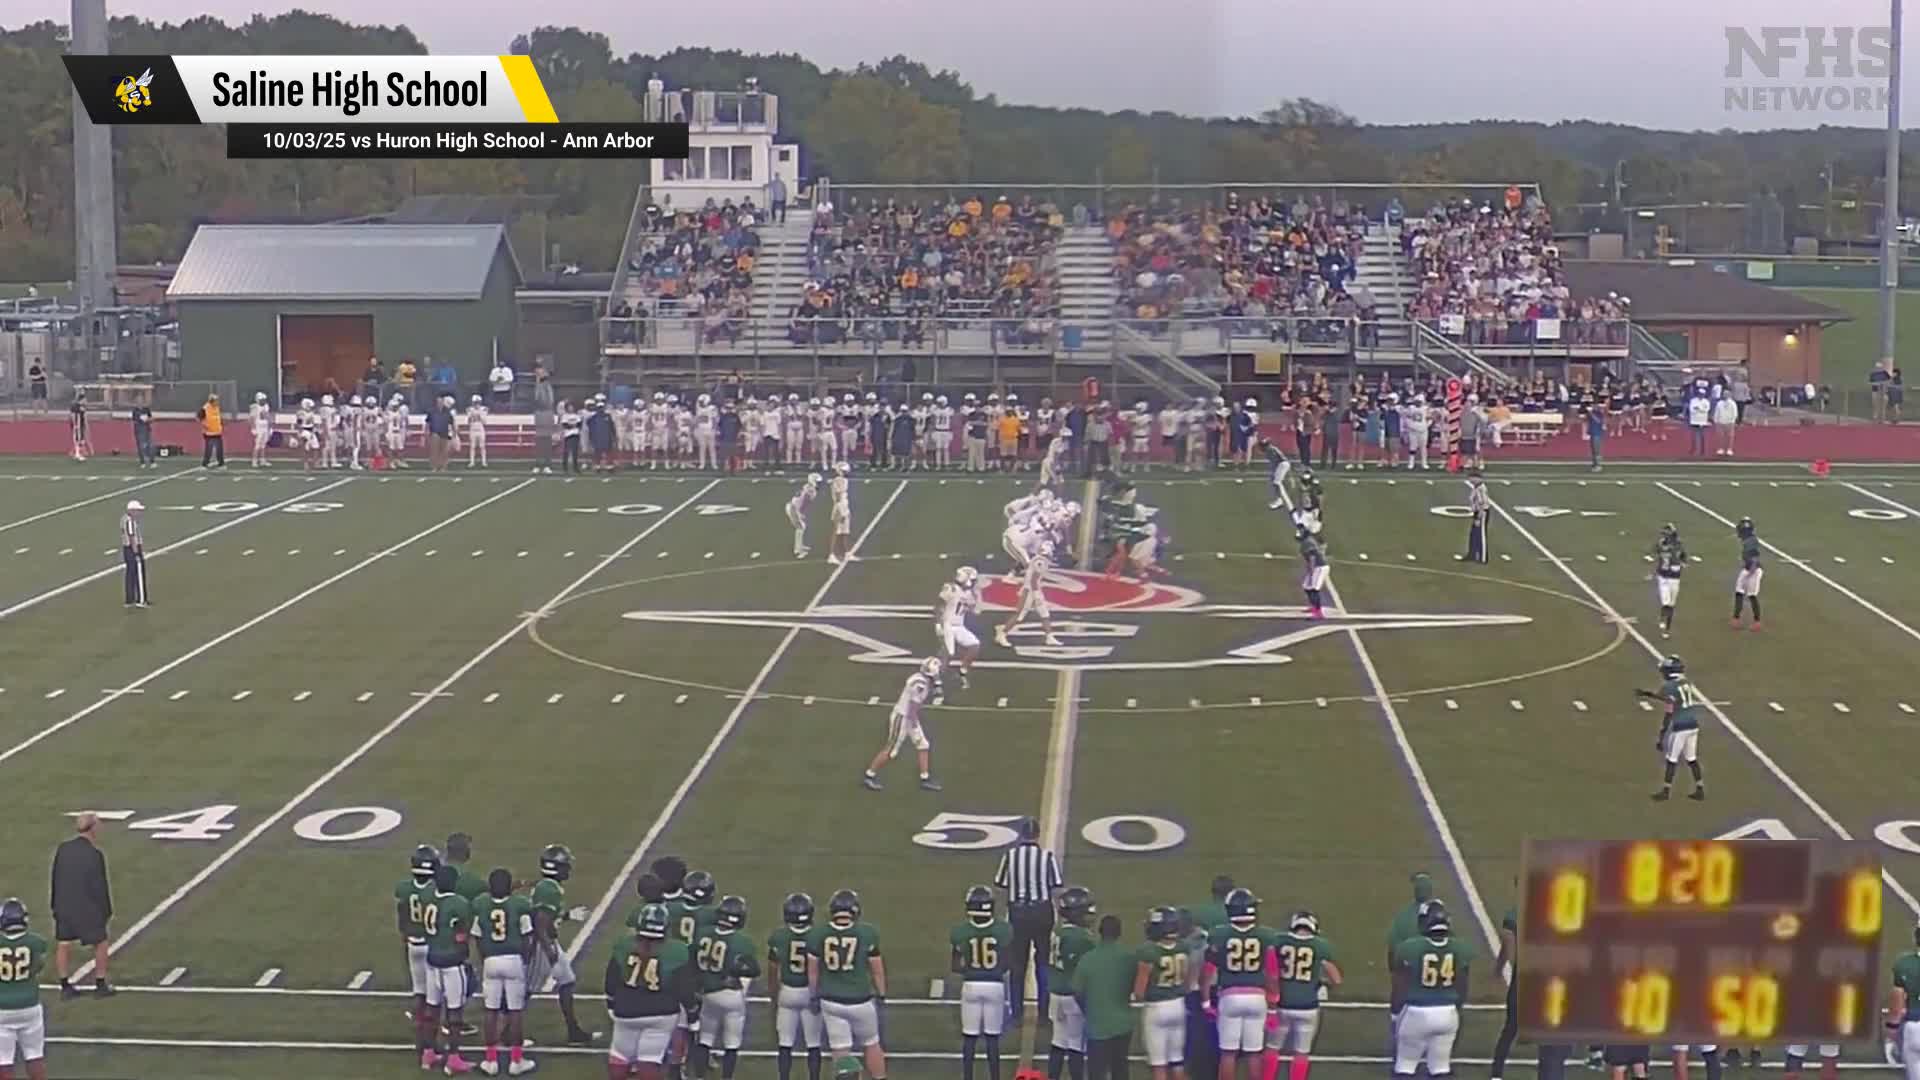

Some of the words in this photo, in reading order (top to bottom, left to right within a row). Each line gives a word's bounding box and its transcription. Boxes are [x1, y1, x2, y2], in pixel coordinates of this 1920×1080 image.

[912, 812, 1186, 851] 50
[1553, 871, 1586, 932] 0
[1846, 873, 1882, 934] 0
[490, 908, 507, 942] 3
[0, 945, 32, 981] 62
[696, 936, 727, 972] 29
[789, 940, 807, 974] 5
[823, 936, 858, 971] 67
[969, 936, 998, 969] 16
[1226, 937, 1262, 972] 22
[1279, 945, 1314, 981] 32
[1421, 953, 1455, 987] 64
[625, 954, 661, 991] 74
[1547, 976, 1567, 1027] 1
[1620, 974, 1671, 1035] 10
[1711, 974, 1779, 1038] 50
[1837, 983, 1858, 1036] 1
